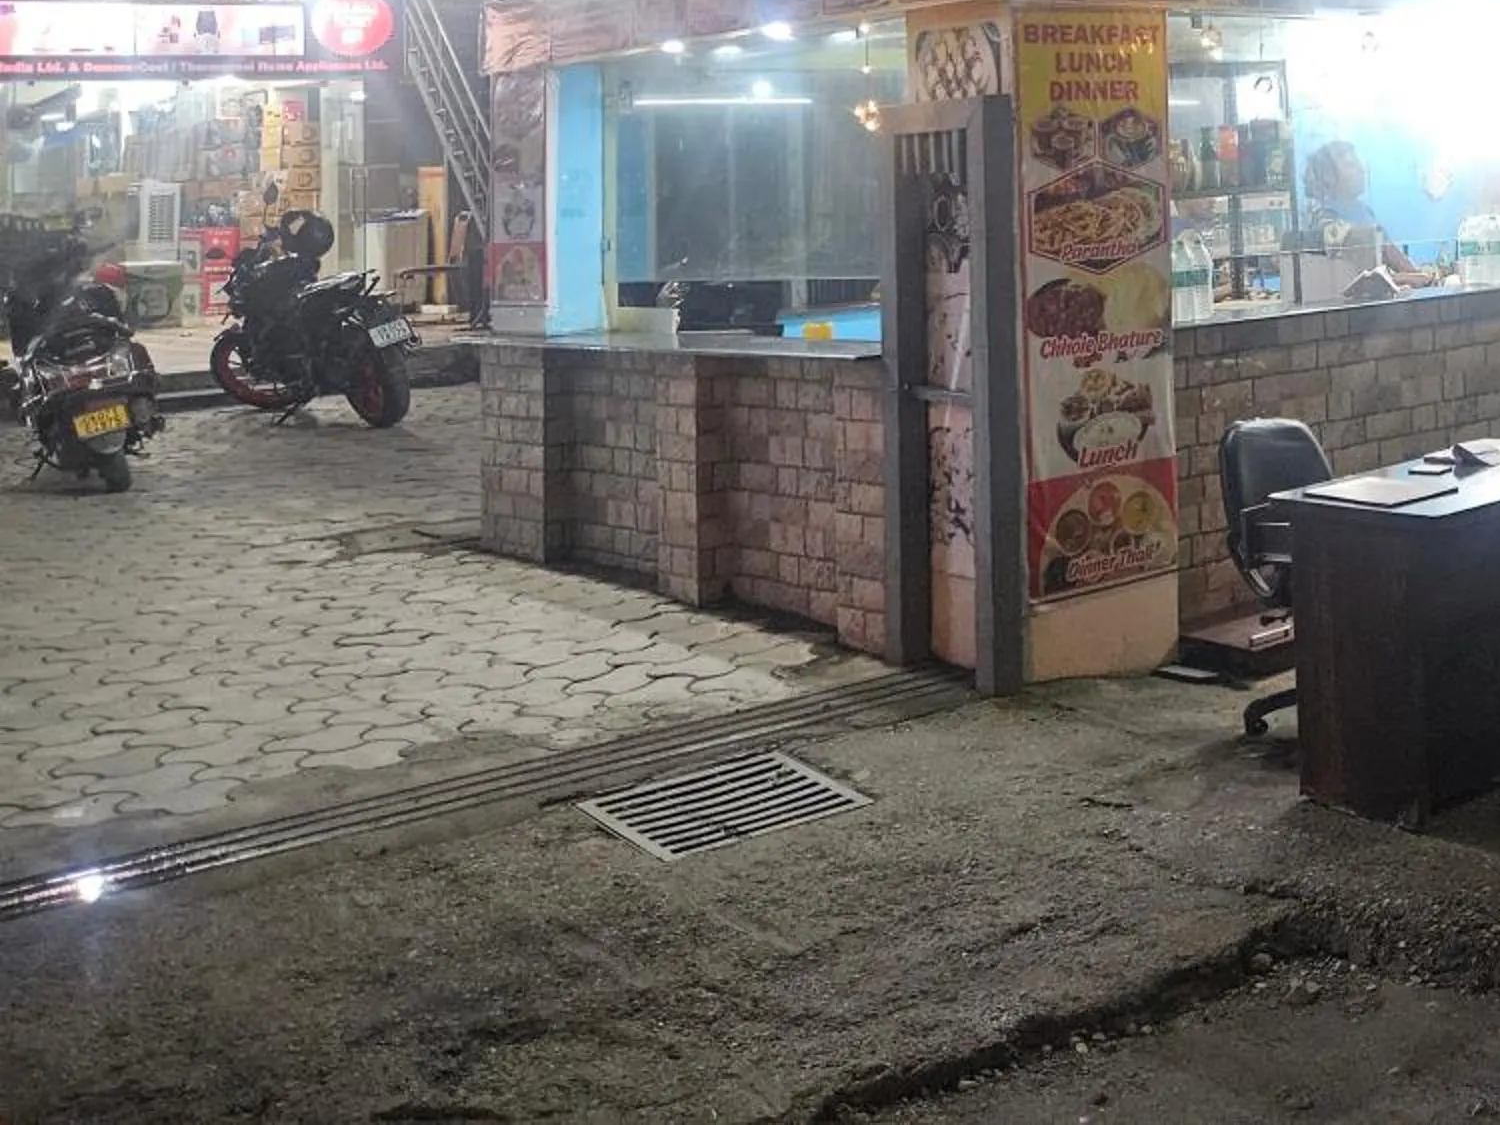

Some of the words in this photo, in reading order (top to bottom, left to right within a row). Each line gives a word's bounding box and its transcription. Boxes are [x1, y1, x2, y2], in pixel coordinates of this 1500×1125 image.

[1024, 24, 1160, 45] BREAKFAST
[1055, 51, 1133, 73] LUNCH
[1050, 79, 1139, 102] DINNER
[1079, 439, 1139, 468] Lunch
[1067, 552, 1116, 581] Dinner
